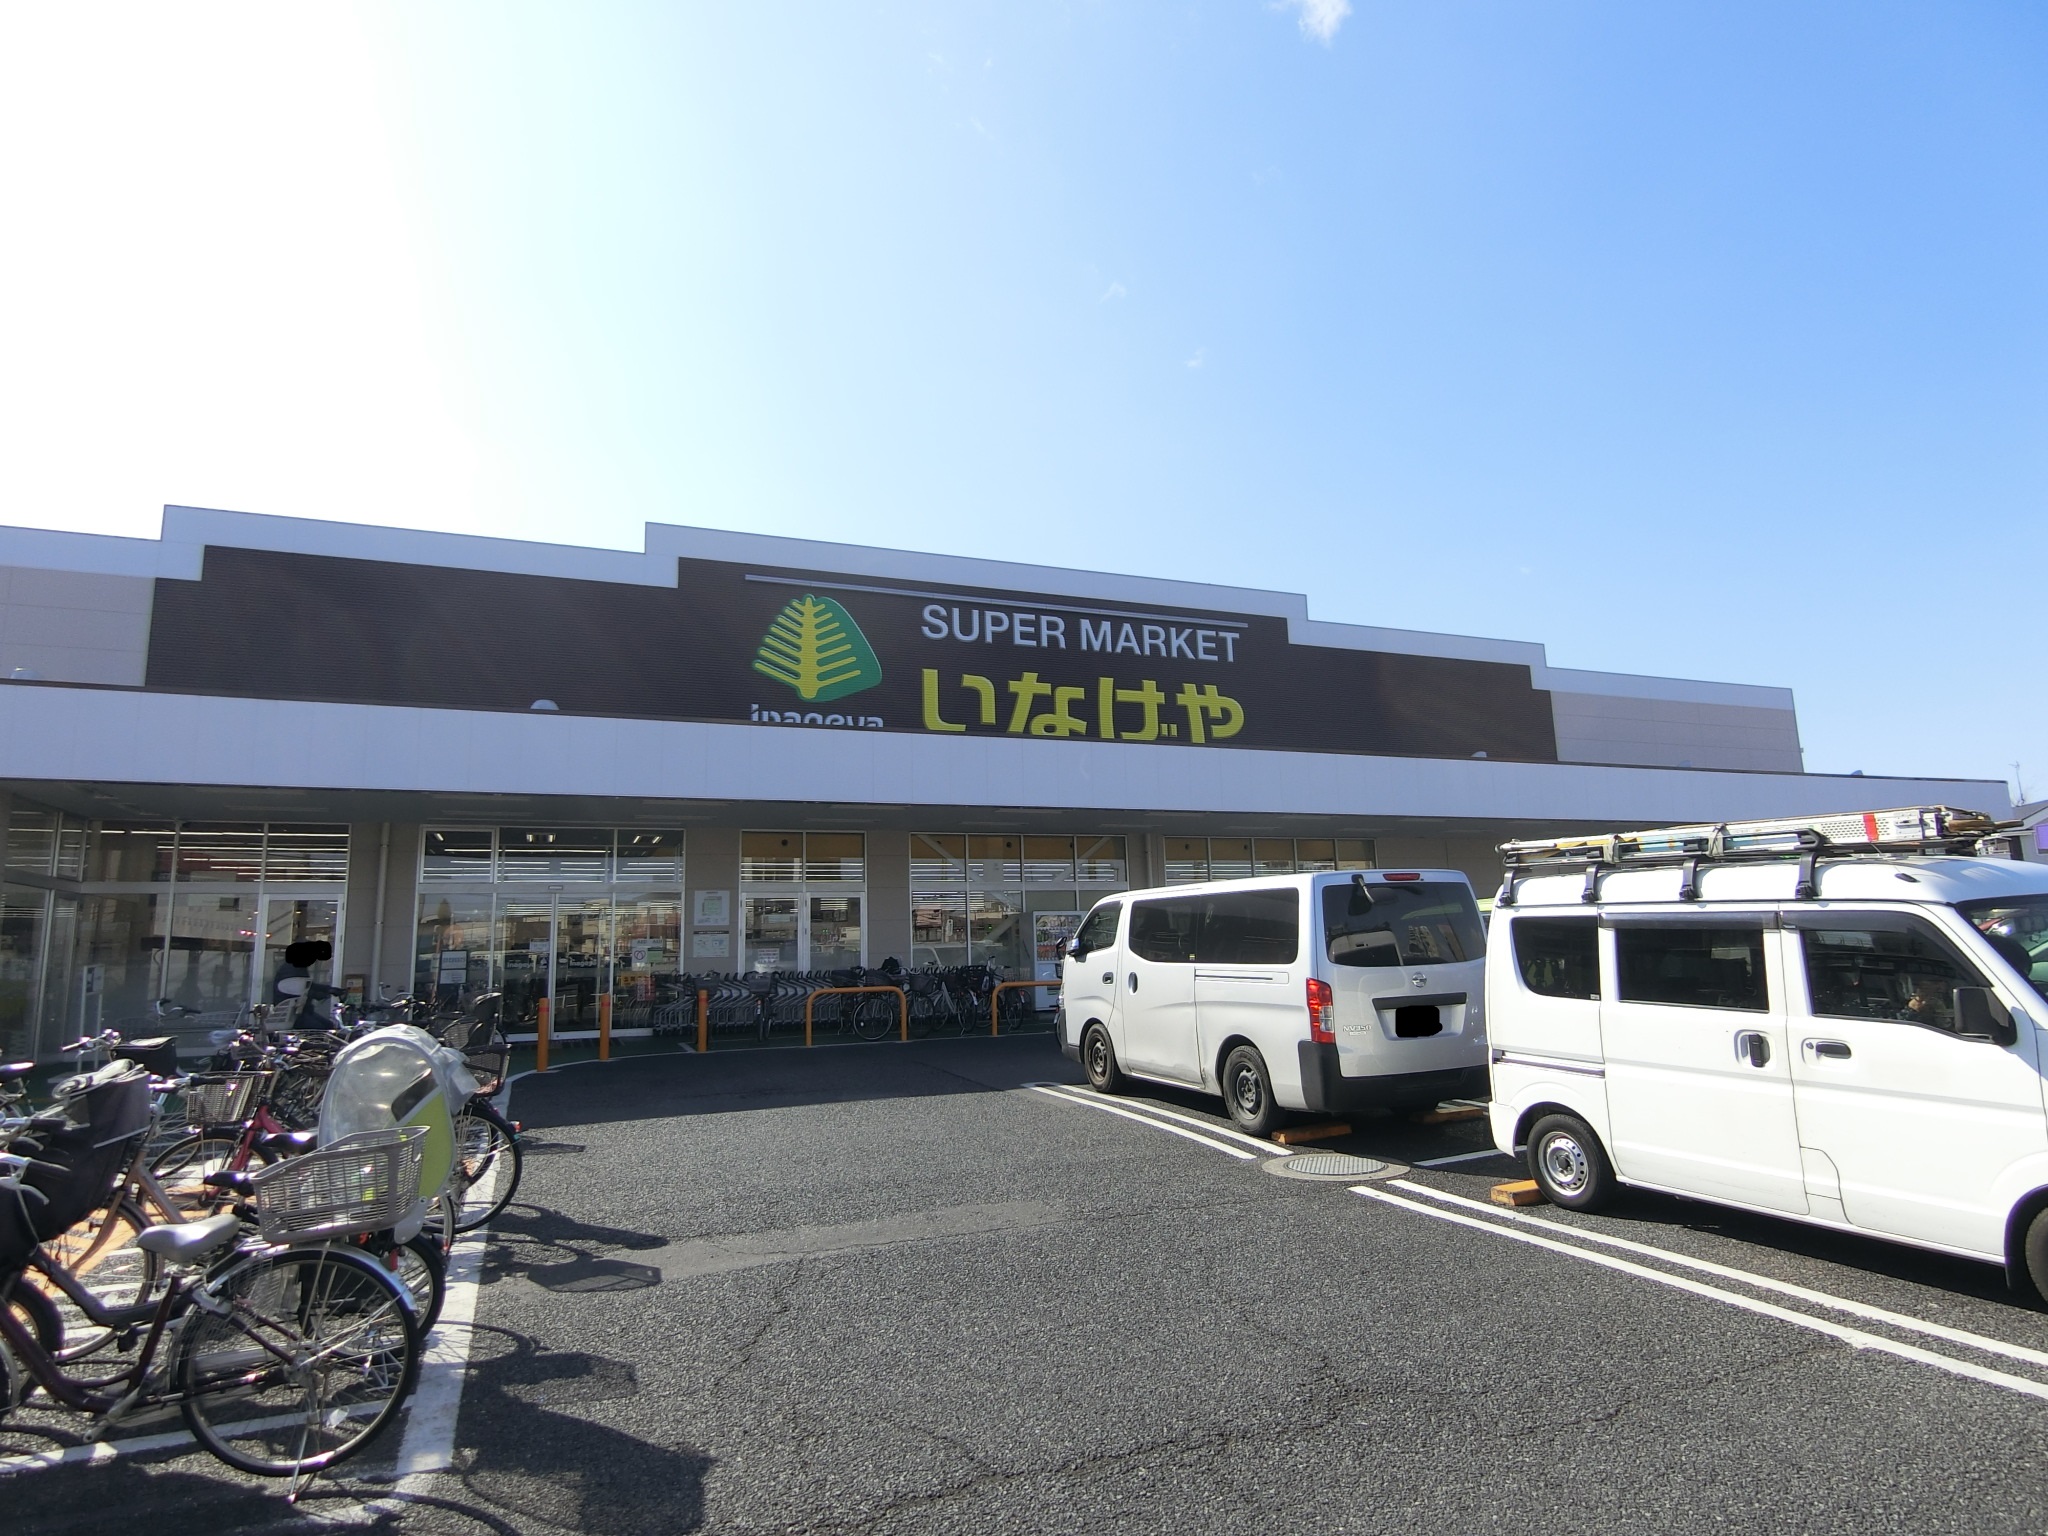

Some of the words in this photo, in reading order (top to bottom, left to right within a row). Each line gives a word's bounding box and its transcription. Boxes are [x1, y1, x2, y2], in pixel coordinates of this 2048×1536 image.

[921, 604, 1066, 650] SUPER
[1079, 618, 1240, 663] MARKET
[921, 668, 1245, 744] いなげや
